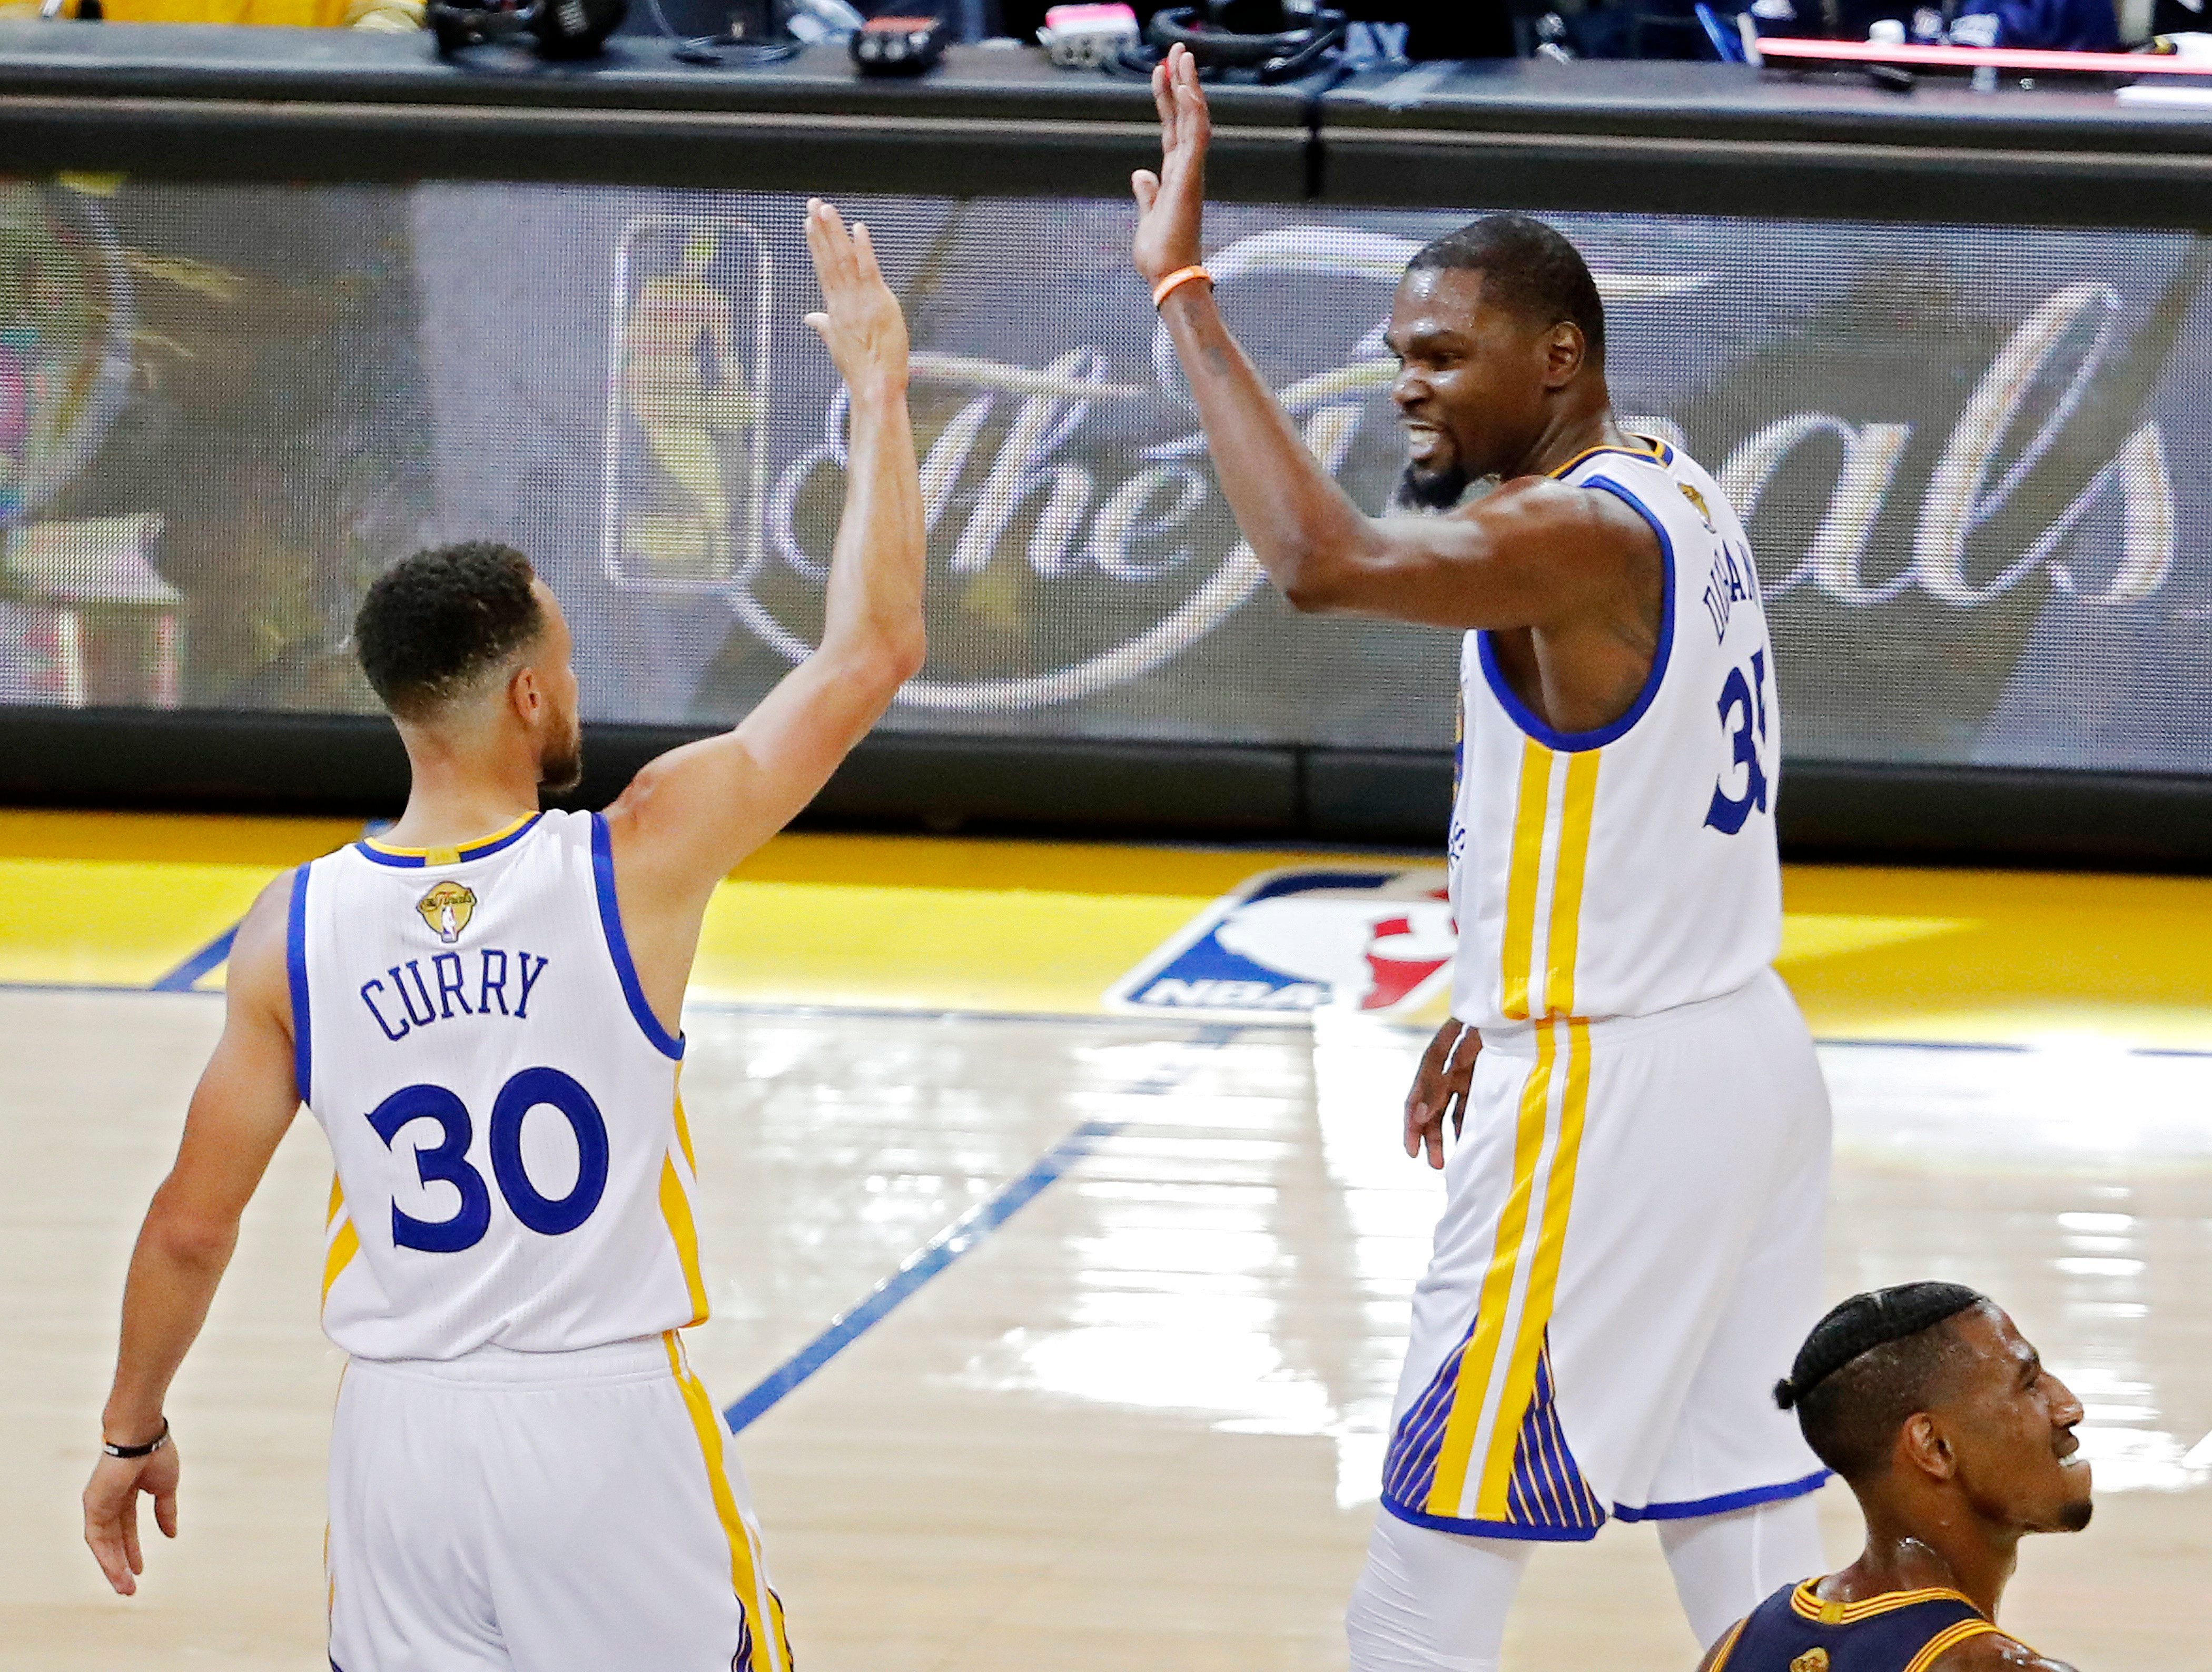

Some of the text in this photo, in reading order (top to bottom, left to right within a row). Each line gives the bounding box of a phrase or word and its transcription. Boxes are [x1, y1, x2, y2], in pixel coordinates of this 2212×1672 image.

[764, 342, 1210, 580] The
[360, 949, 548, 1041] CURRY
[1139, 978, 1318, 1007] NBA
[364, 1066, 609, 1253] 30
